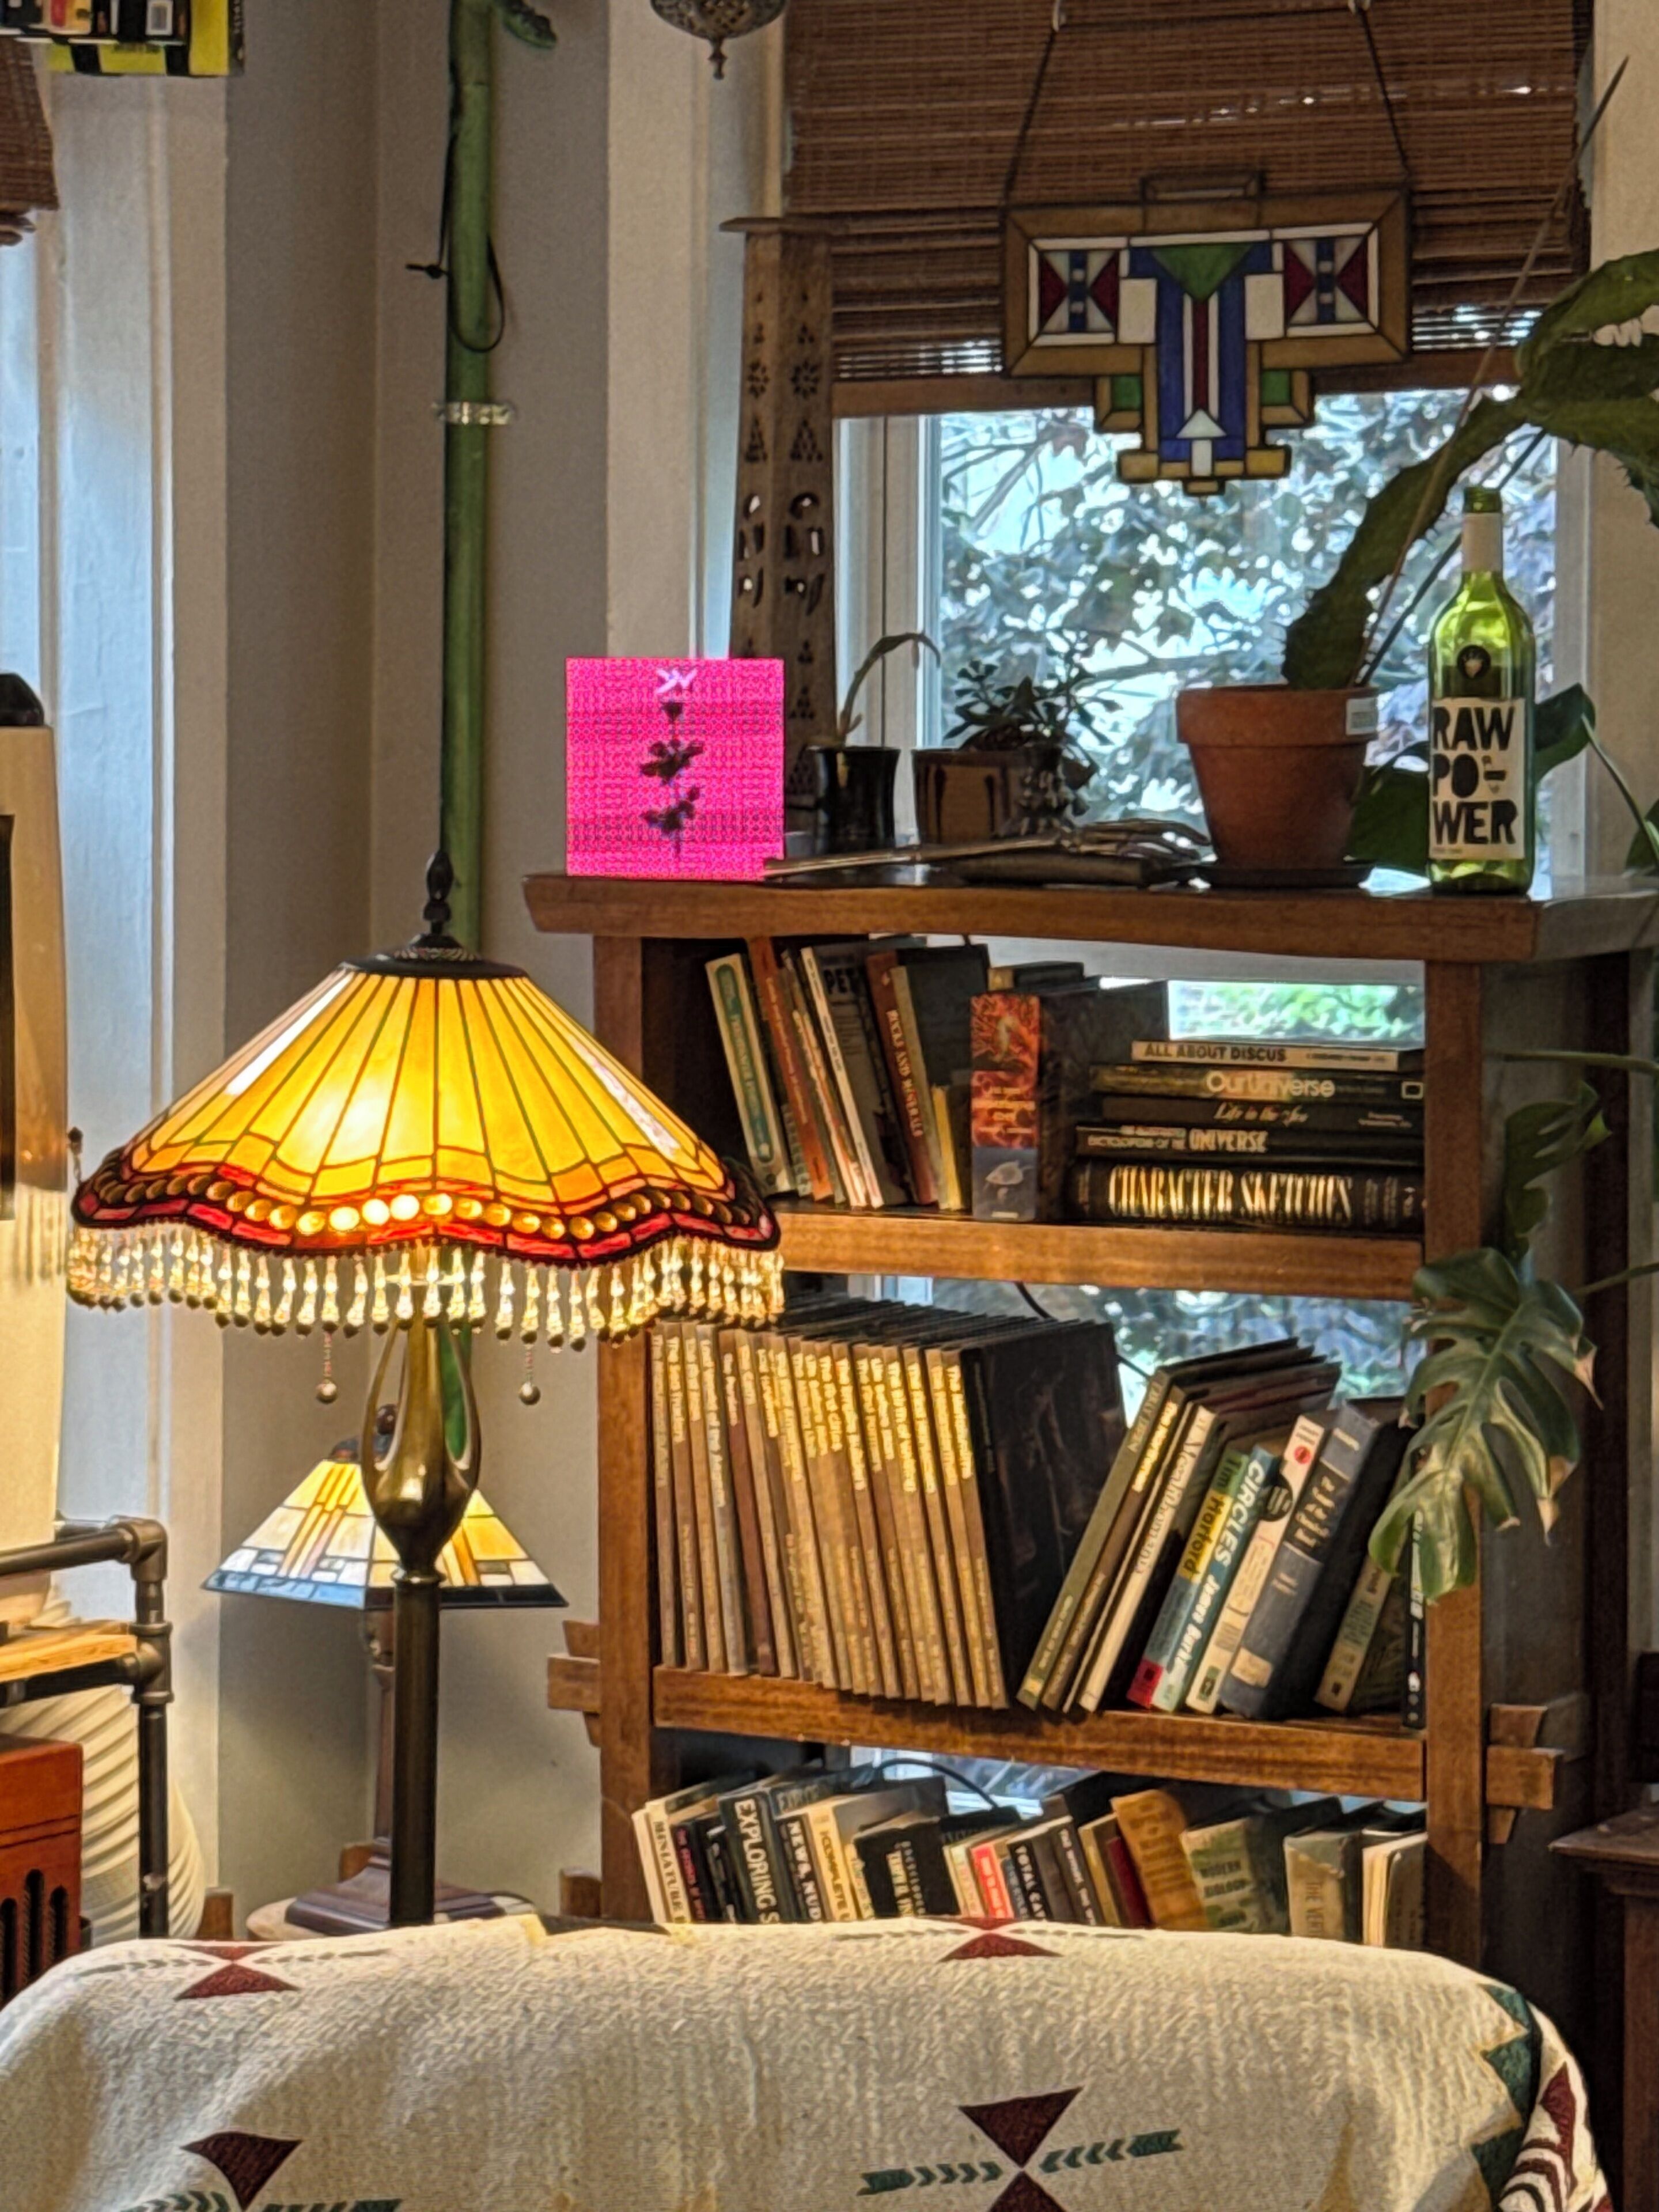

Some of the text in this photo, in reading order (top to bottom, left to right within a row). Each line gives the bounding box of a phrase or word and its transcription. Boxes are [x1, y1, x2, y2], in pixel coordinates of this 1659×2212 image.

[1433, 706, 1515, 751] RAW
[1433, 800, 1518, 844] WER
[1145, 1042, 1286, 1062] ALL ABOUT DISCUS
[1189, 1128, 1267, 1152] UNIVERSE
[1109, 1165, 1234, 1221] CHARACTER
[1241, 1170, 1354, 1225] SKETCHES
[1184, 1457, 1243, 1578] Tim Harford
[1215, 1459, 1265, 1567] CIRCLES
[734, 1797, 778, 1909] EXPLORING
[1014, 1845, 1036, 1891] TOTAL
